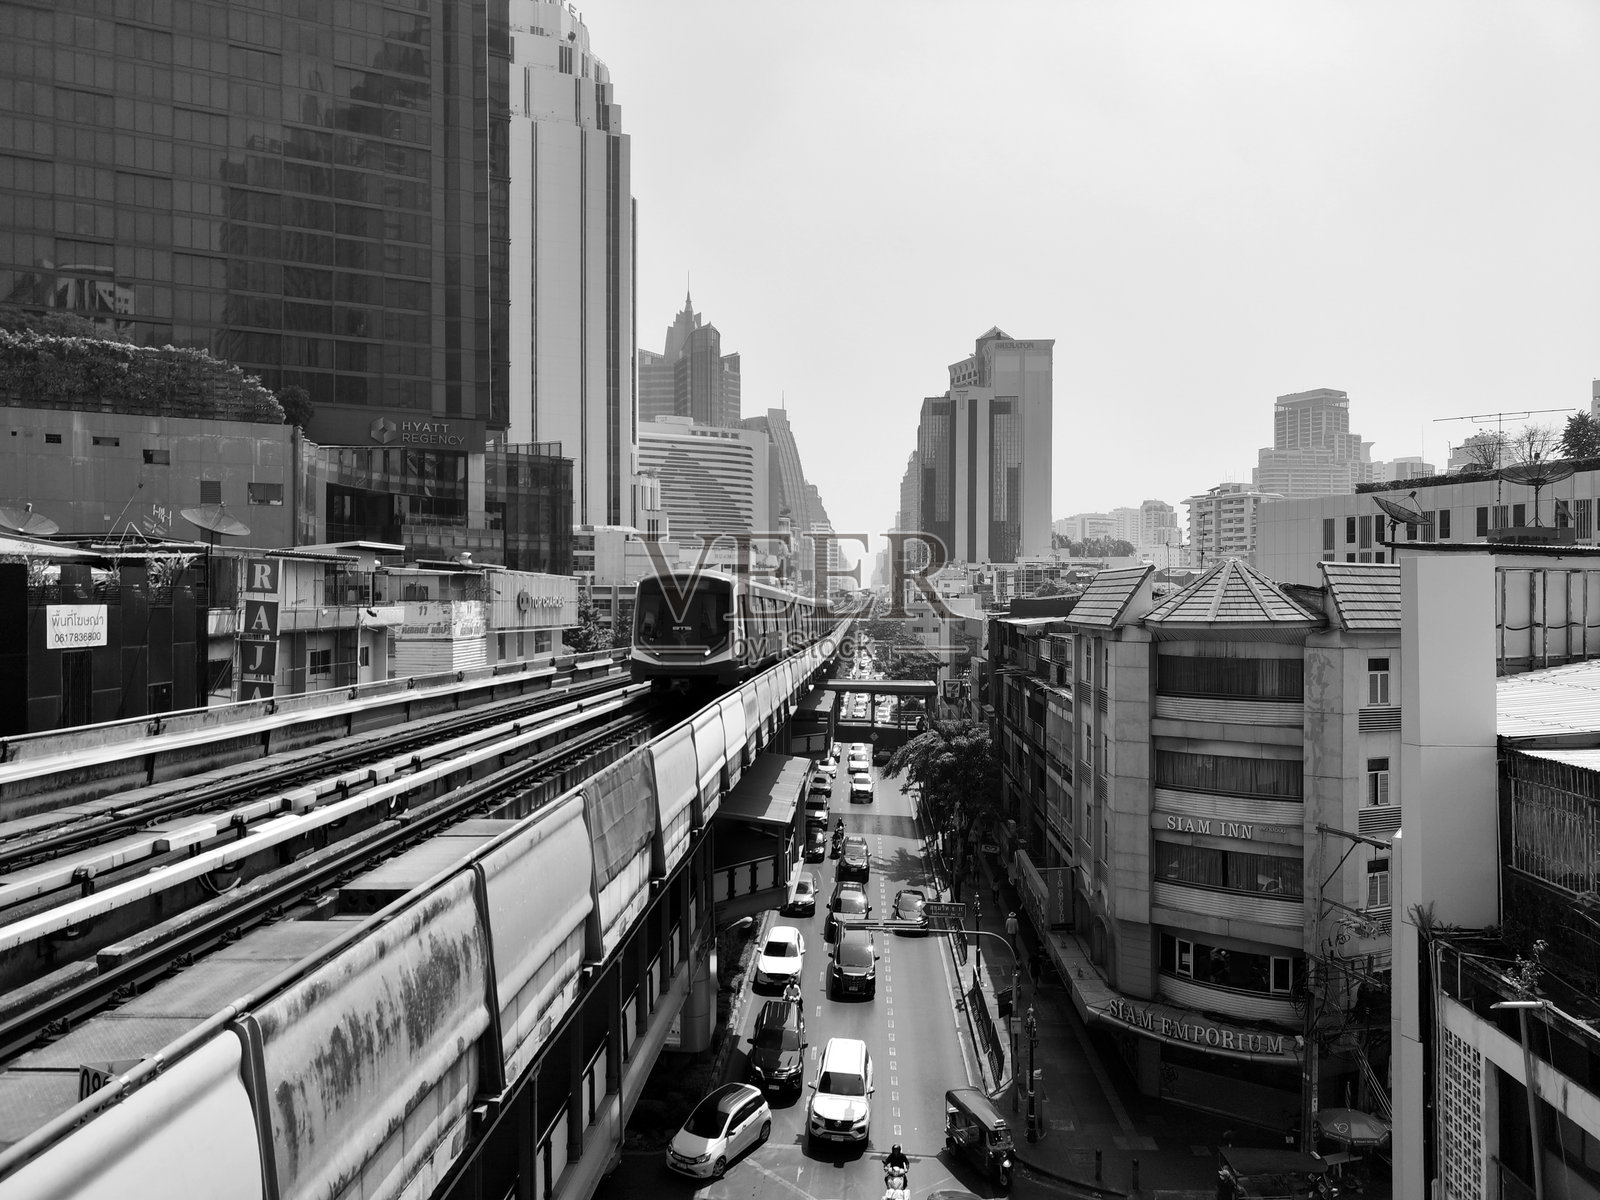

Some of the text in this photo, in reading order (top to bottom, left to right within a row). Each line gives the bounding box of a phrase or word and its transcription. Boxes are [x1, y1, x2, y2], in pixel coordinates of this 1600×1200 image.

[402, 420, 450, 433] HYATT
[402, 432, 465, 445] REGENCY
[54, 631, 102, 643] 0617836800
[1167, 815, 1211, 835] SIAM
[1220, 822, 1252, 839] INN
[1109, 999, 1284, 1054] SIAM EMPORIUM
